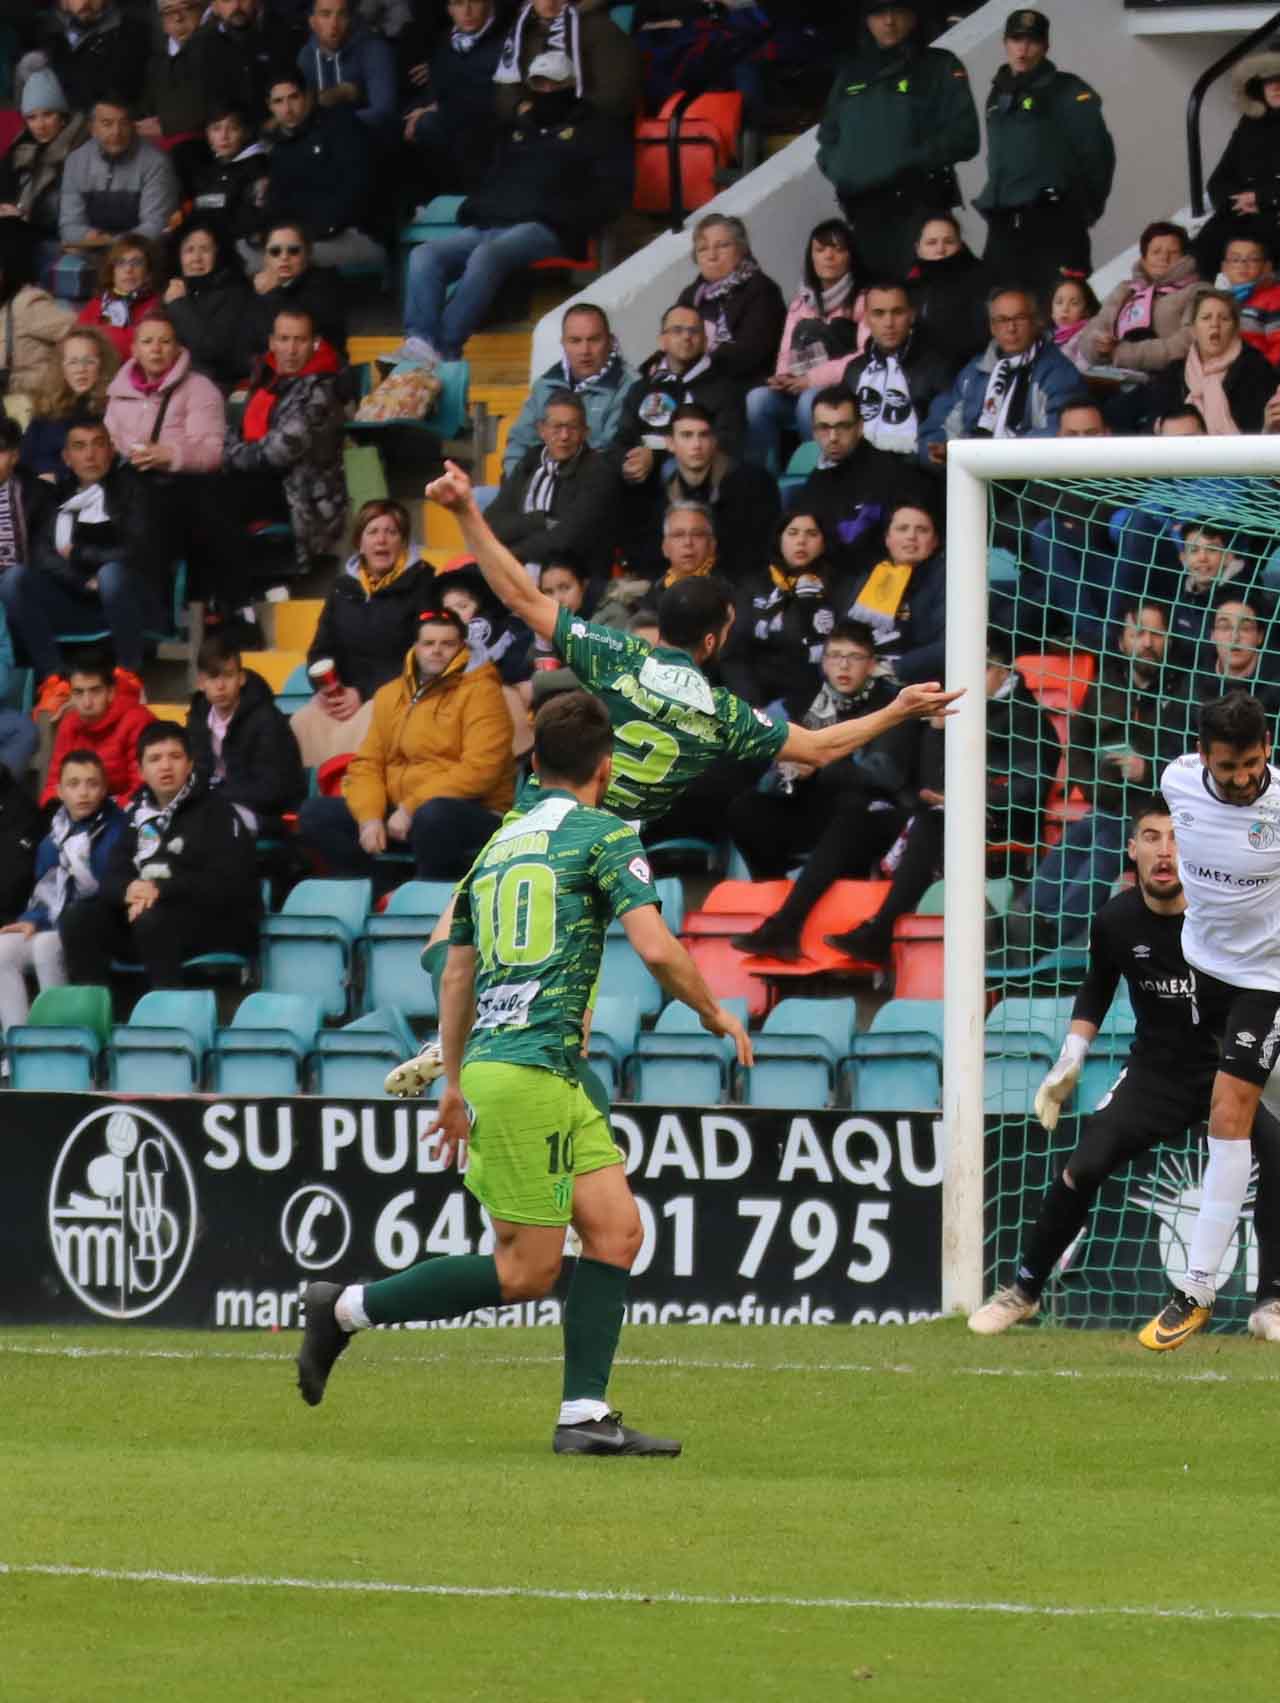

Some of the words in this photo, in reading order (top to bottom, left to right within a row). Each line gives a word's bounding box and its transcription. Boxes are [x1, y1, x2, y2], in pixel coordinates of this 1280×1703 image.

[605, 719, 681, 808] 2
[472, 863, 556, 975] 10
[203, 1104, 293, 1171] SU
[545, 1131, 575, 1175] 10
[737, 1200, 892, 1283] 795
